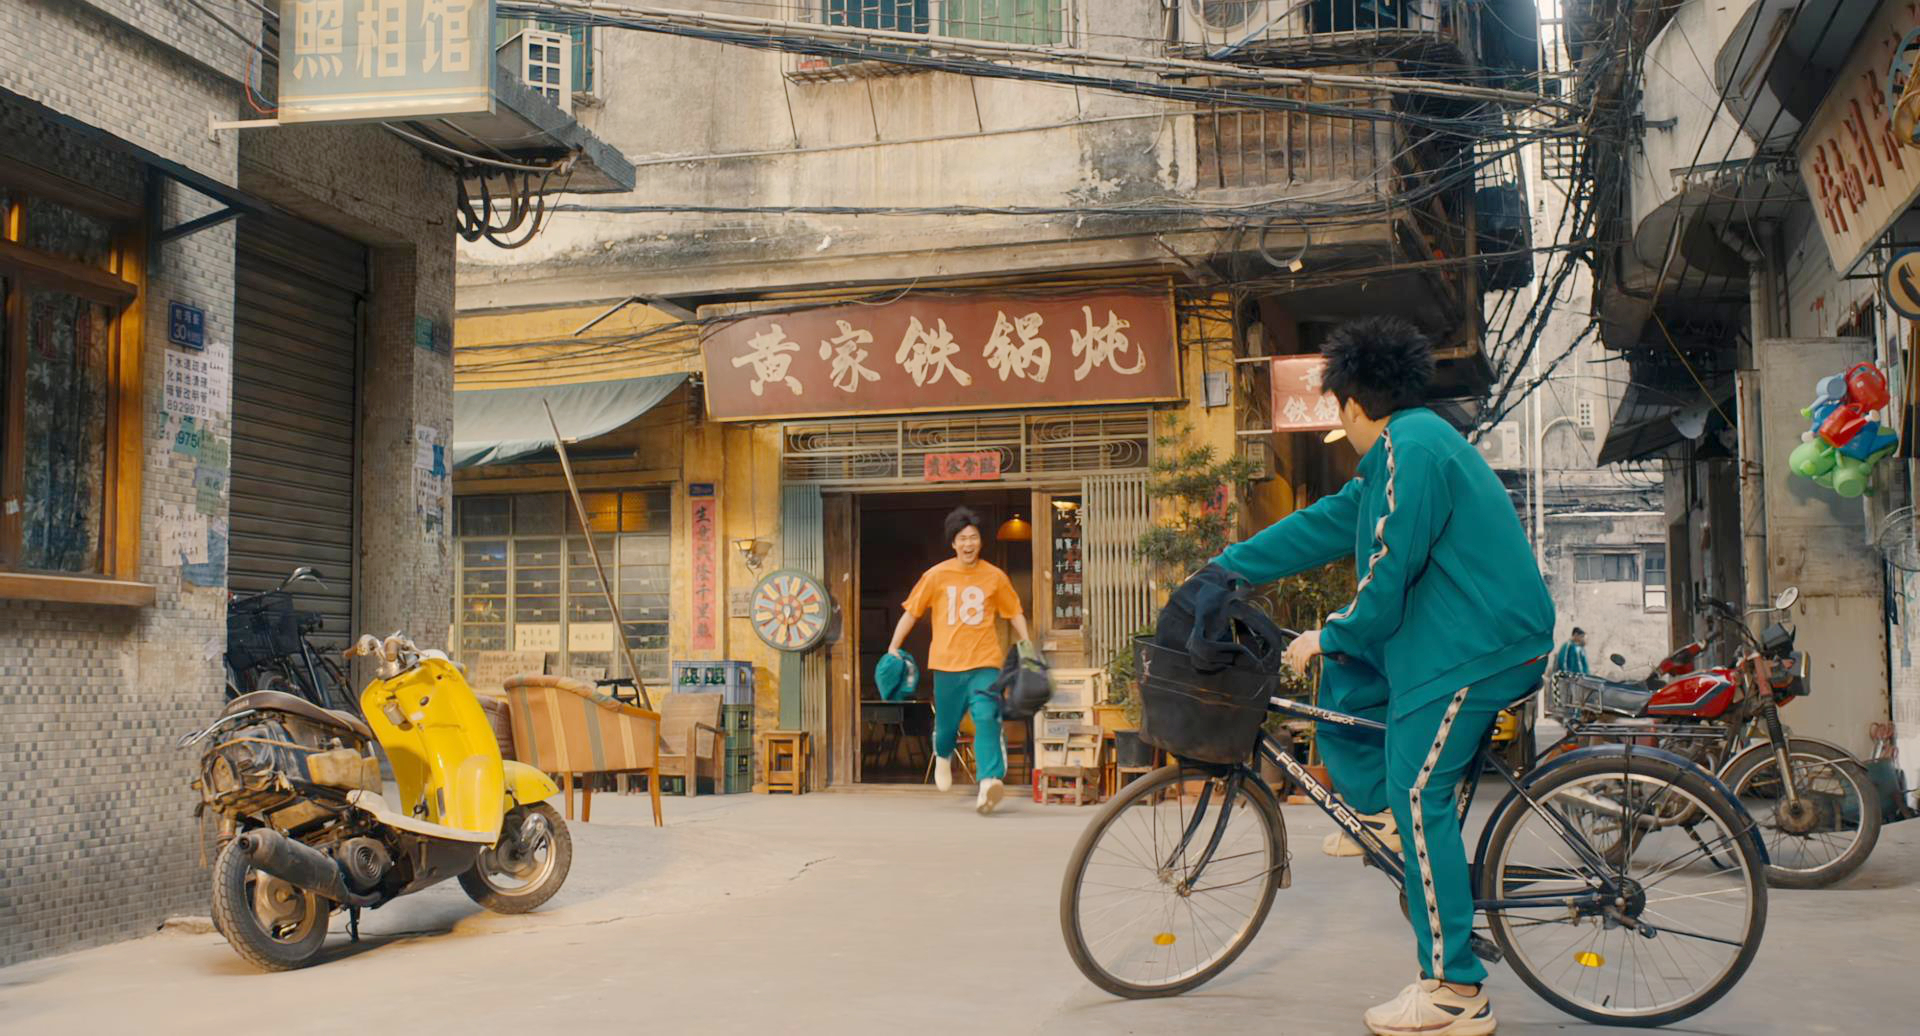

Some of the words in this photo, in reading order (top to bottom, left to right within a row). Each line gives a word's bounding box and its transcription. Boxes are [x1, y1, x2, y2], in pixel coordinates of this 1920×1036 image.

[292, 0, 474, 80] 照相馆
[731, 305, 1147, 396] 黄家铁锅炖
[947, 585, 985, 626] 18
[1276, 752, 1361, 834] FOREVER
